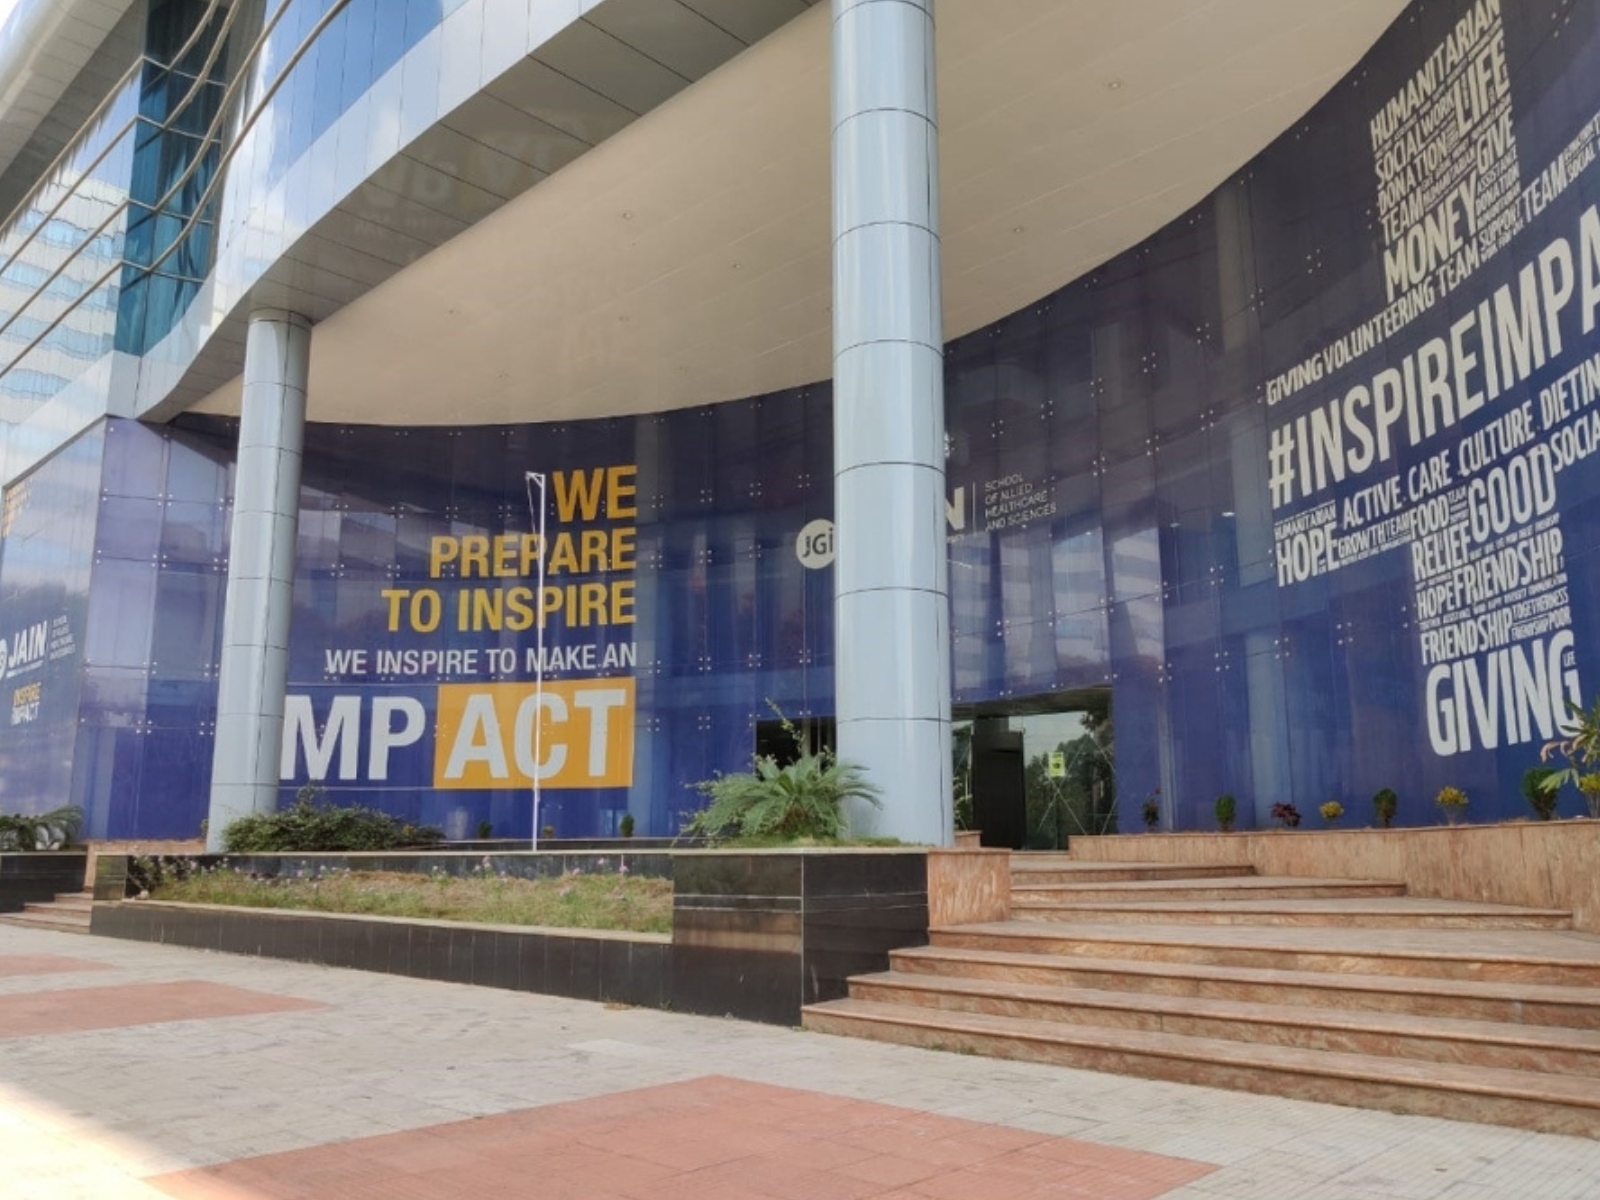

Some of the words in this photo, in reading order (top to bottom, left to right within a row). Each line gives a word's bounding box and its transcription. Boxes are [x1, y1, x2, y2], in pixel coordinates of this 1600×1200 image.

[1370, 0, 1500, 152] HUMANITARIAN
[1454, 29, 1510, 138] LIFE
[1375, 122, 1425, 191] SOCIAL
[1421, 88, 1455, 137] WORK
[1477, 106, 1516, 175] GIVE
[1377, 132, 1447, 217] DONATION
[1382, 186, 1424, 246] TEAM
[1384, 169, 1478, 304] MONEY
[1266, 353, 1323, 405] GIVING
[1323, 275, 1436, 375] VOLUNTEERING
[1436, 236, 1480, 297] TEAM
[1522, 153, 1568, 223] TEAM
[552, 465, 638, 523] WE
[985, 473, 1024, 492] SCHOOL
[985, 492, 999, 506] OF
[1001, 484, 1034, 500] ALLIED
[1344, 475, 1402, 531] ACTIVE
[1408, 449, 1453, 502] CARE
[1459, 401, 1536, 477] CULTURE
[1468, 443, 1556, 543] GOOD
[985, 490, 1048, 519] HEALTHCARE
[985, 517, 1006, 533] AND
[1008, 502, 1057, 526] SCIENCES
[1339, 522, 1385, 558] GROWTH
[1410, 494, 1450, 540] FOOD
[430, 527, 637, 578] PREPARE
[1276, 521, 1340, 588] HOPE
[1411, 520, 1471, 582] RELIEF
[1416, 581, 1454, 620] HOPE
[1453, 527, 1563, 608] FRIENDSHIP
[381, 589, 442, 633] TO
[458, 581, 637, 632] INSPIRE
[1421, 607, 1514, 666] FRIENDSHIP
[8, 620, 48, 669] JAIN
[325, 649, 367, 675] WE
[376, 649, 478, 675] INSPIRE
[486, 648, 517, 674] TO
[526, 644, 596, 672] MAKE
[603, 642, 637, 668] AN
[1426, 629, 1586, 757] GIVING
